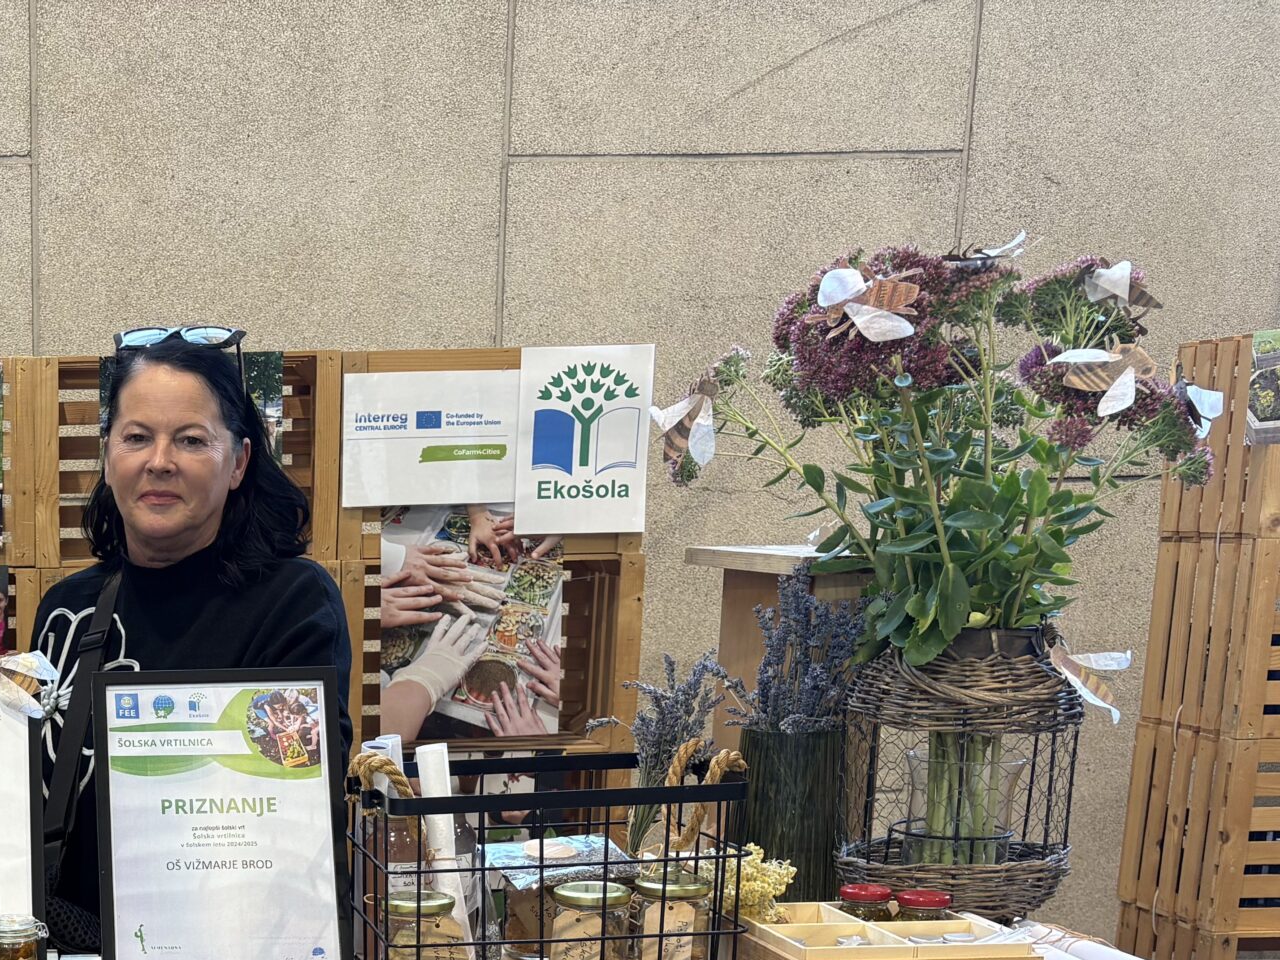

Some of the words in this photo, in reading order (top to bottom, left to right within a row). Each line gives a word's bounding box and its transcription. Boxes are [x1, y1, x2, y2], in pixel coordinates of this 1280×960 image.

[355, 412, 408, 424] Interreg
[476, 412, 483, 420] by
[355, 424, 383, 432] CENTRAL
[456, 419, 484, 427] European
[536, 479, 630, 501] Ekošola
[119, 709, 136, 717] FEE
[117, 737, 157, 748] ŠOLSKA
[160, 738, 213, 747] VRTILNICA
[161, 796, 278, 817] PRIZNANJE
[166, 858, 181, 871] OŠ
[184, 858, 238, 870] VIŽMARJE
[241, 859, 273, 869] BROD
